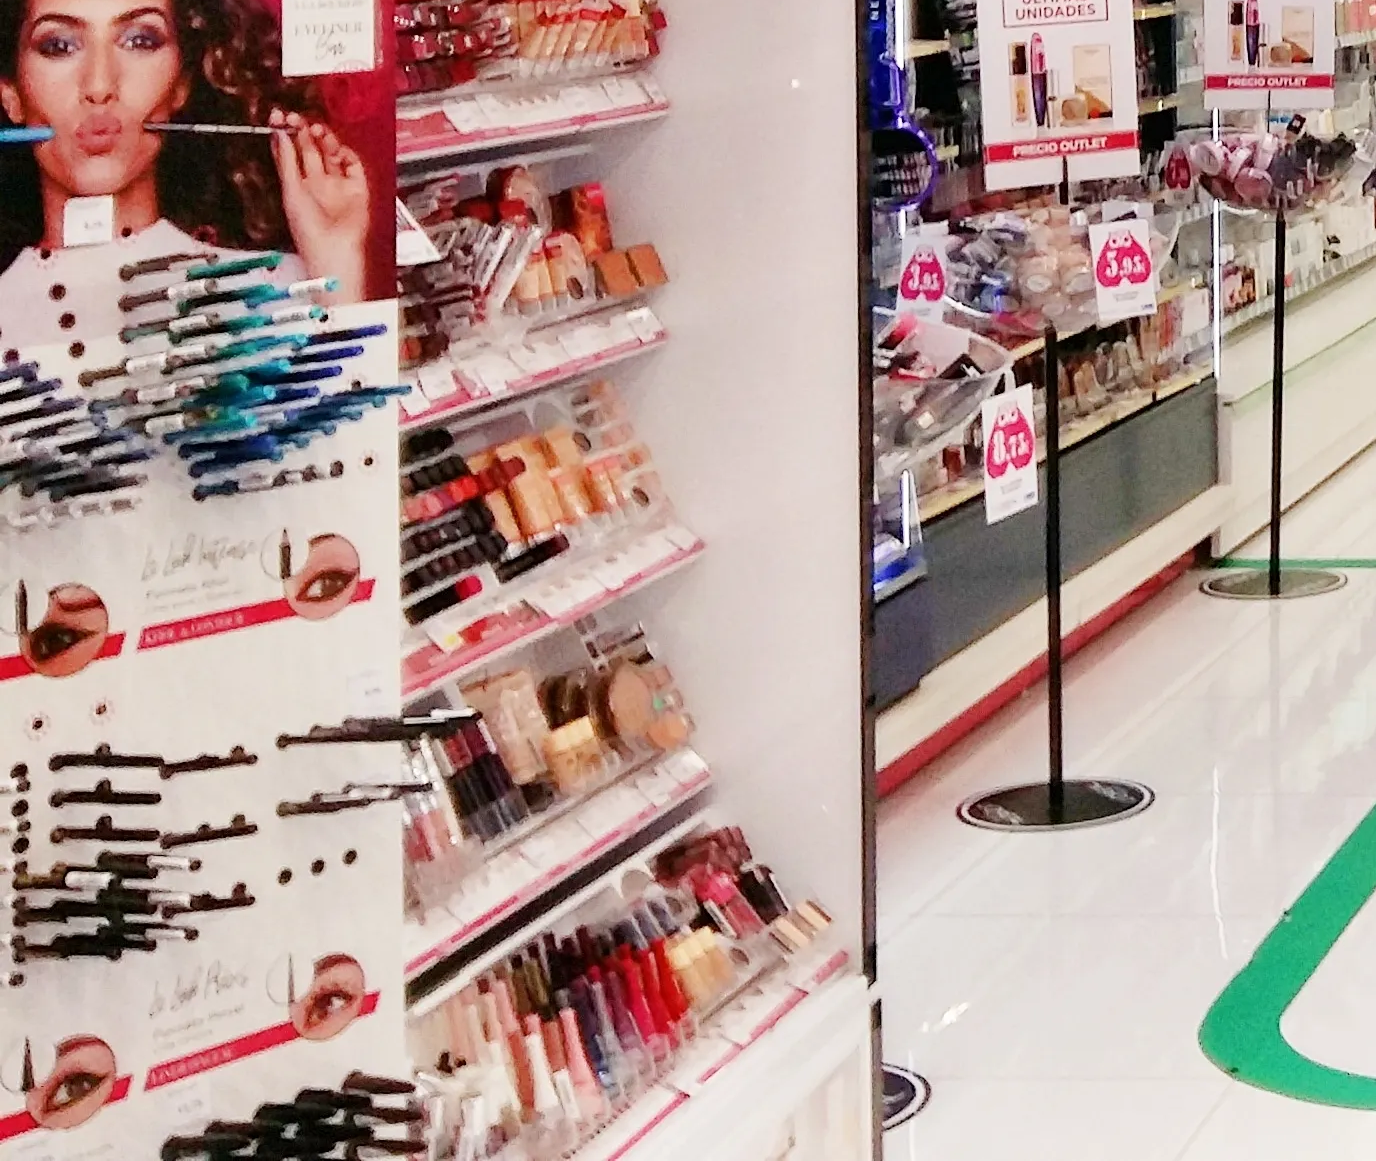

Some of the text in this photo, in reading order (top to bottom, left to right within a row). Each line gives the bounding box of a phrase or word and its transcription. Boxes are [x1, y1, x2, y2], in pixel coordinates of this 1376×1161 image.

[1014, 3, 1096, 20] UNIDADES
[1227, 76, 1308, 87] PRECIO OUTLET
[1013, 137, 1109, 158] PRECIO OUTLET
